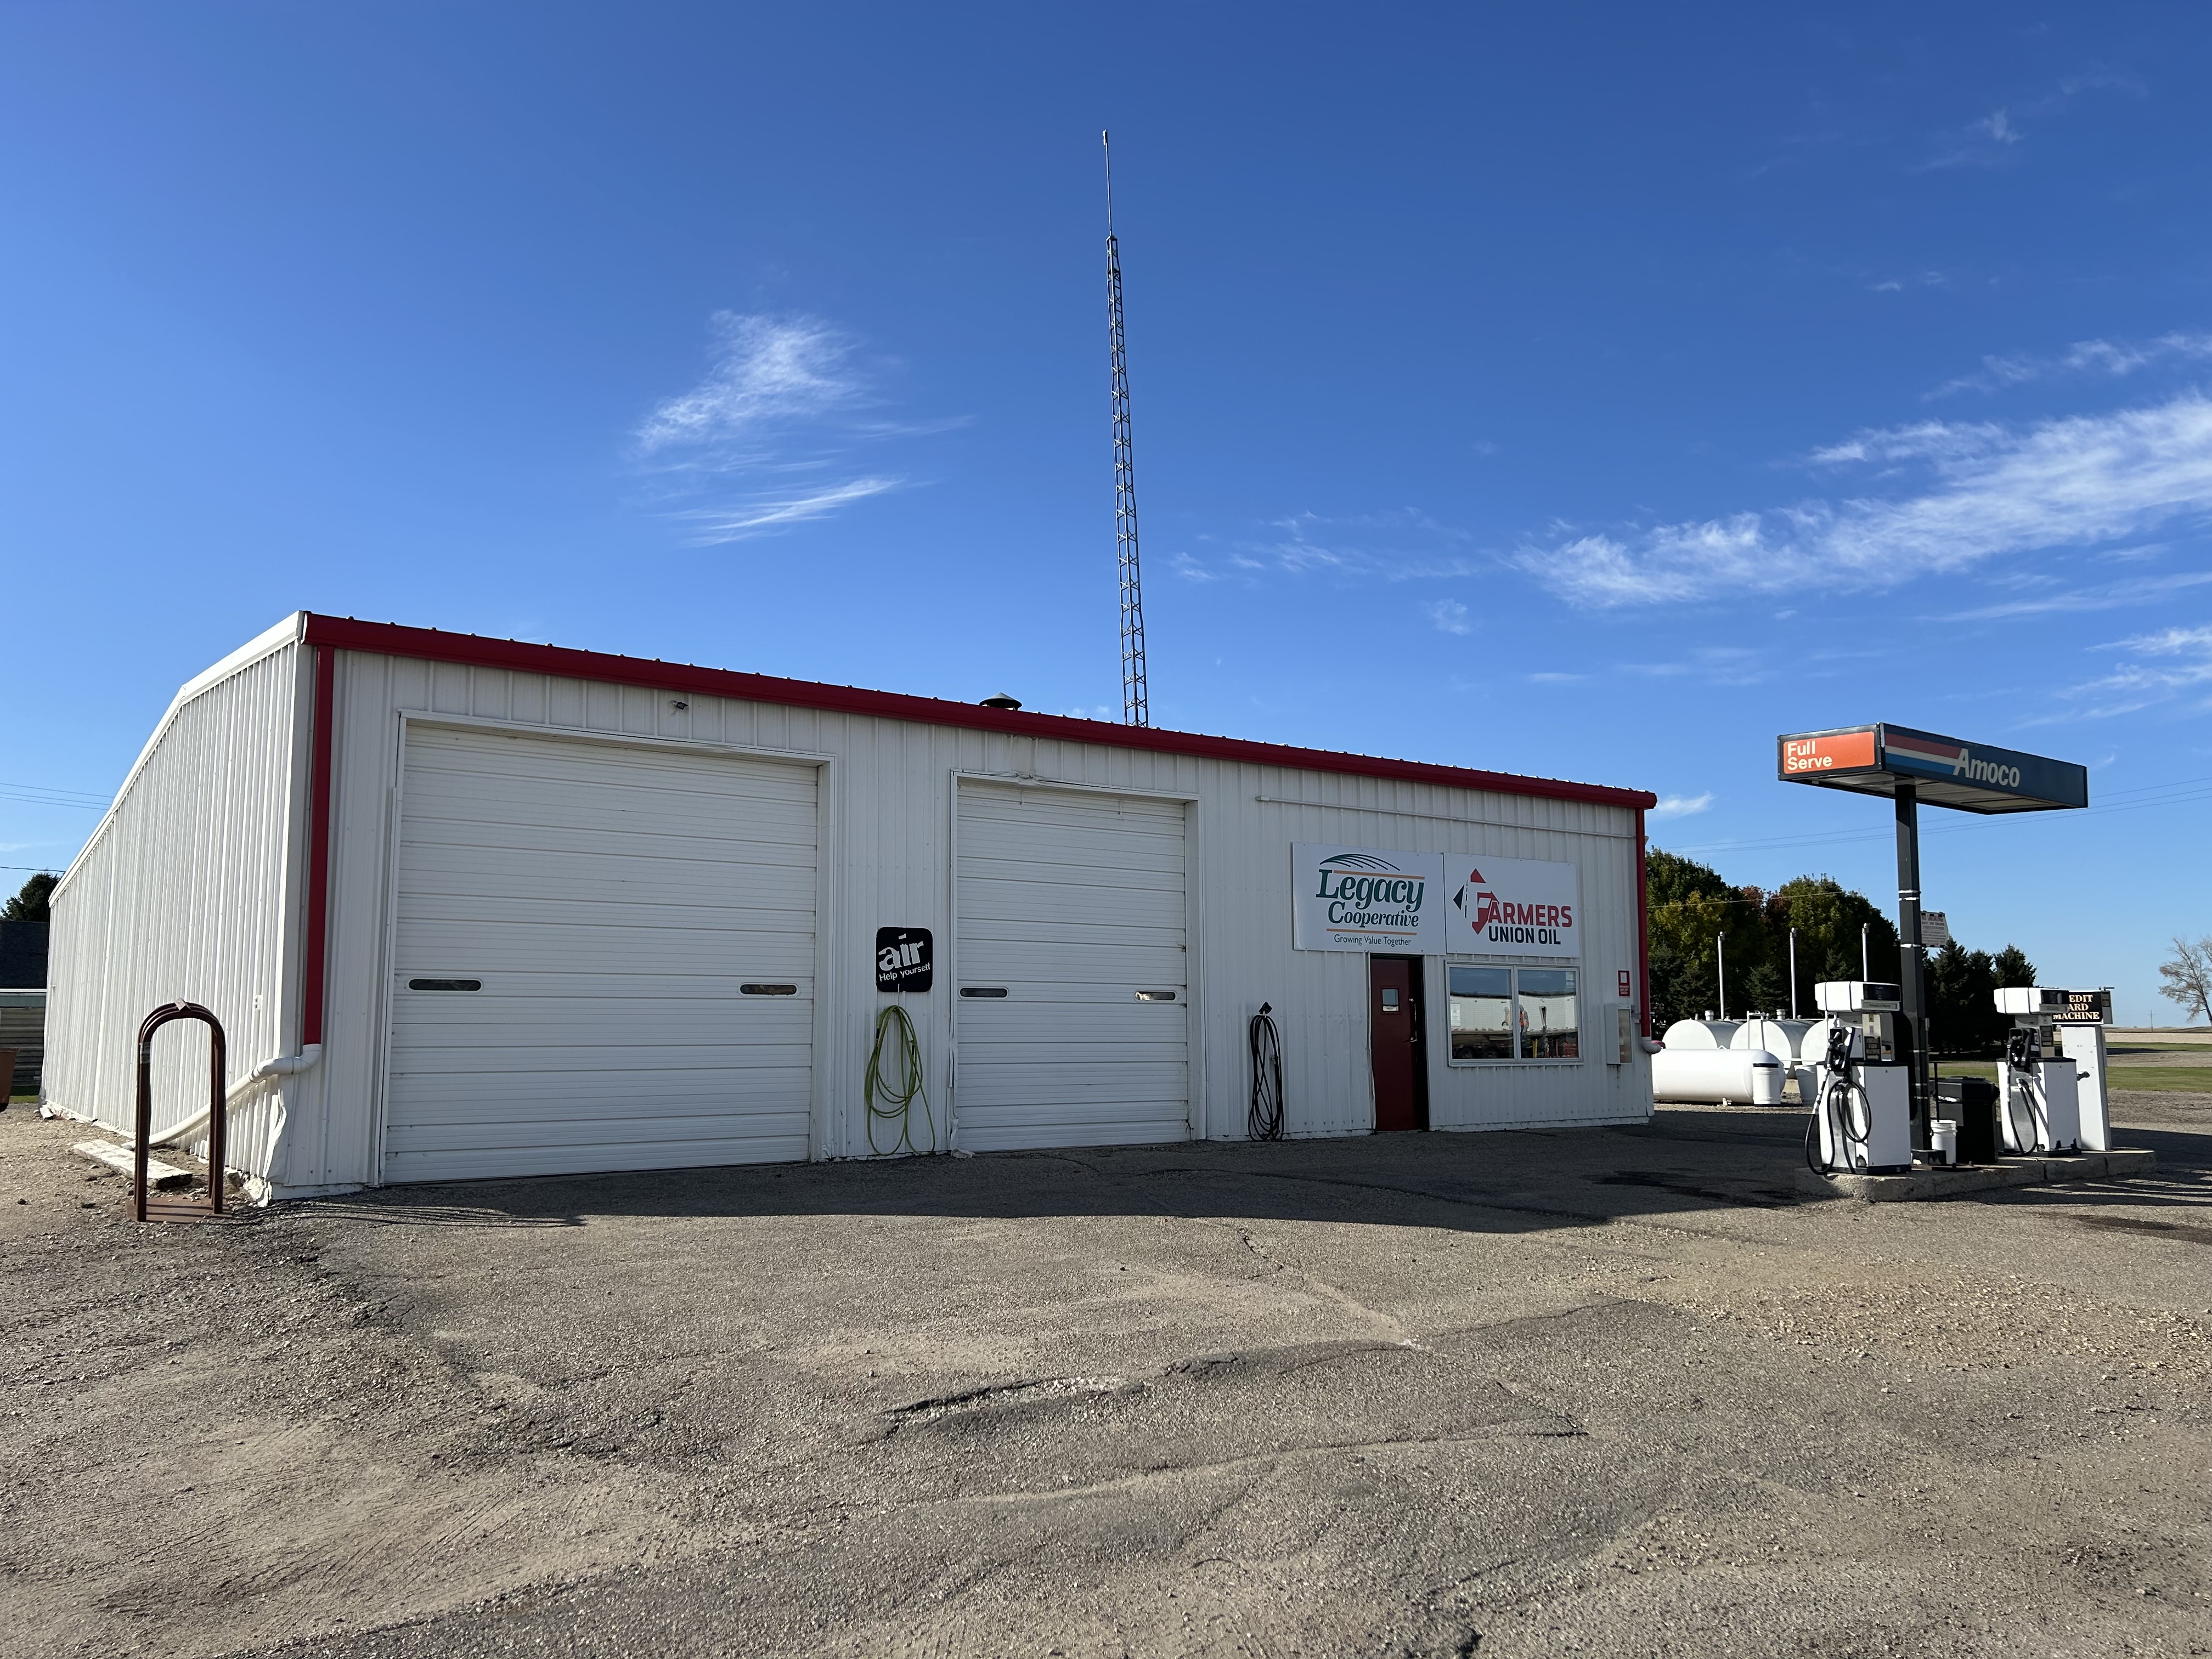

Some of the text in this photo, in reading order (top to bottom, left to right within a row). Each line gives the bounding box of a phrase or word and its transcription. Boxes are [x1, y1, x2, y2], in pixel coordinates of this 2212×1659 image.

[1787, 740, 1816, 757] Full
[1787, 756, 1832, 771] Serve
[1953, 747, 2020, 788] Amoco
[1316, 869, 1425, 913] Legacy
[1328, 901, 1419, 928] Cooperative
[1334, 934, 1412, 947] Growing Value Together
[1488, 926, 1561, 945] UNION OIL
[878, 933, 924, 971] air
[879, 962, 931, 982] Help yourself
[2068, 1003, 2089, 1011] ARD
[2069, 994, 2094, 1003] EDIT
[2053, 1012, 2100, 1020] MACHINE
[1858, 1034, 1861, 1043] 1
